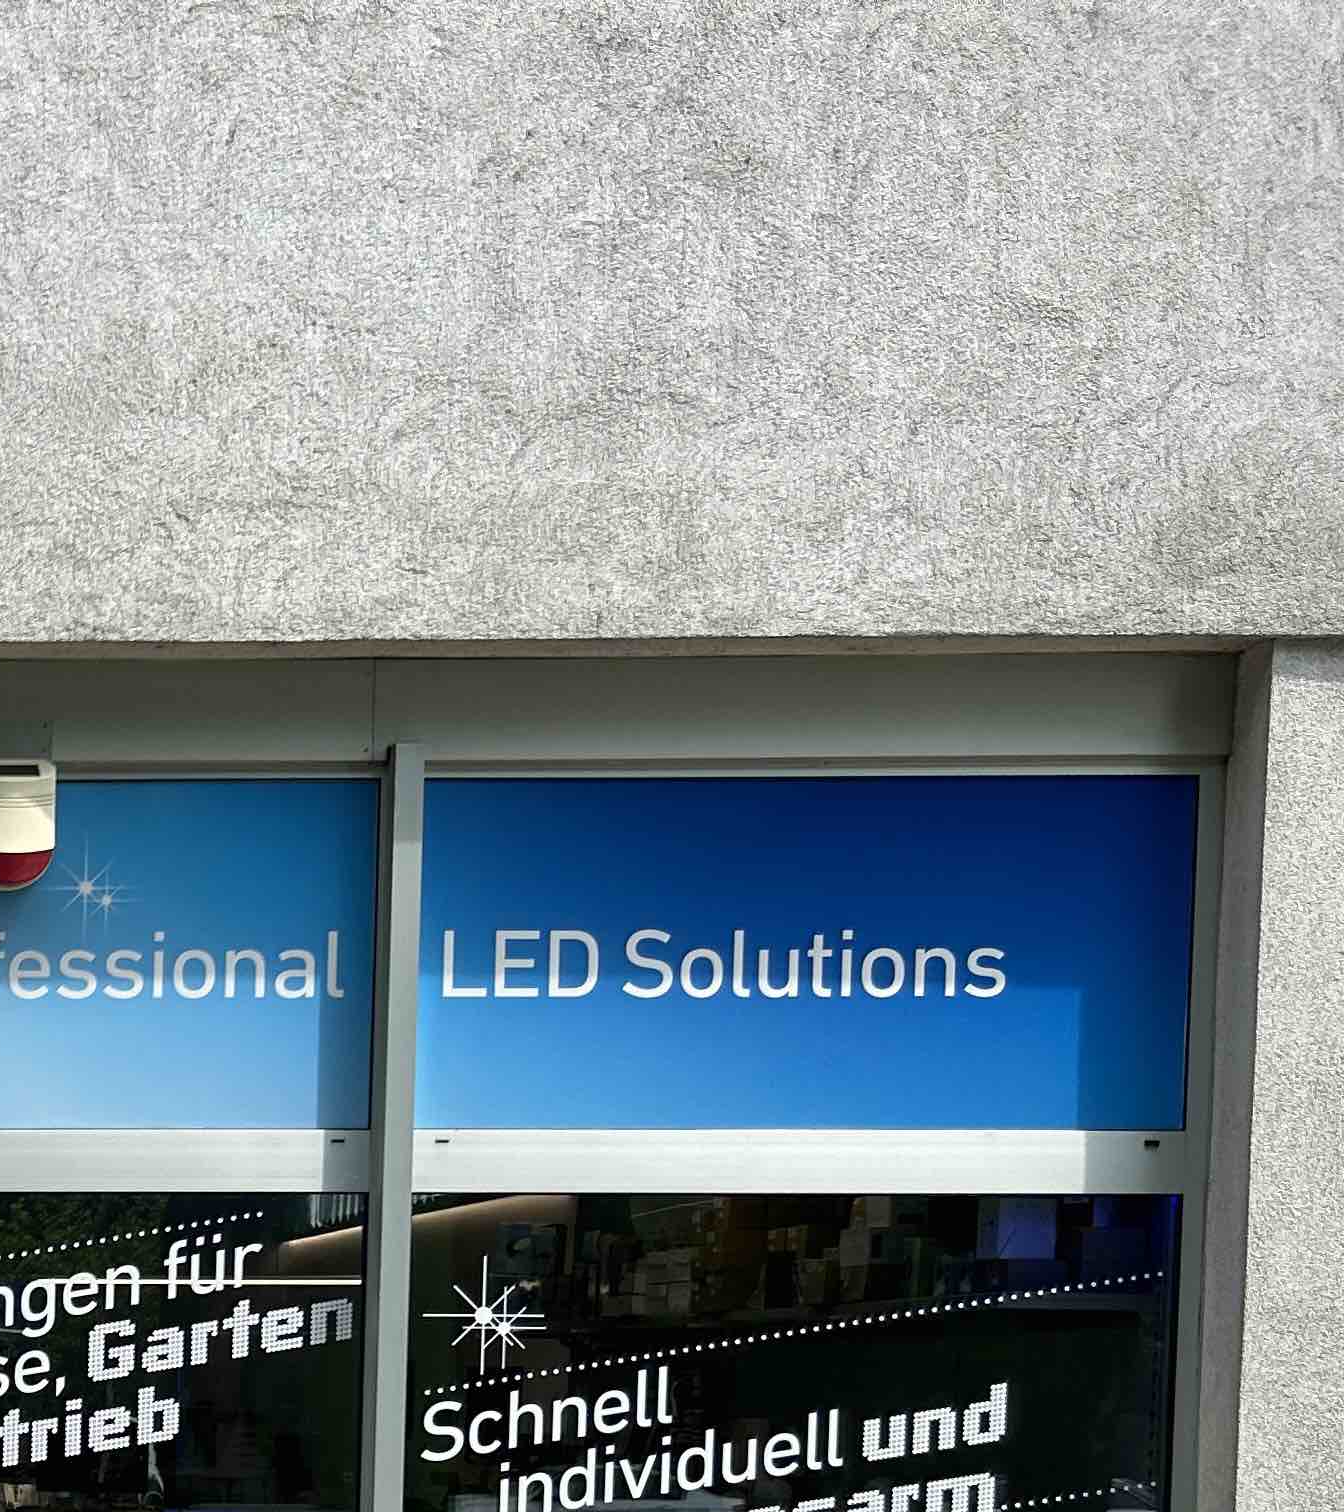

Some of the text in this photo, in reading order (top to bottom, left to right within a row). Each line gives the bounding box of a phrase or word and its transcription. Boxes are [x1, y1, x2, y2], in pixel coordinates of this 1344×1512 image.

[441, 929, 599, 998] LED
[621, 929, 1007, 998] Solutions
[166, 1232, 263, 1299] für
[87, 1297, 354, 1383] Garten
[421, 1366, 673, 1462] Schnell
[863, 1382, 1008, 1463] und
